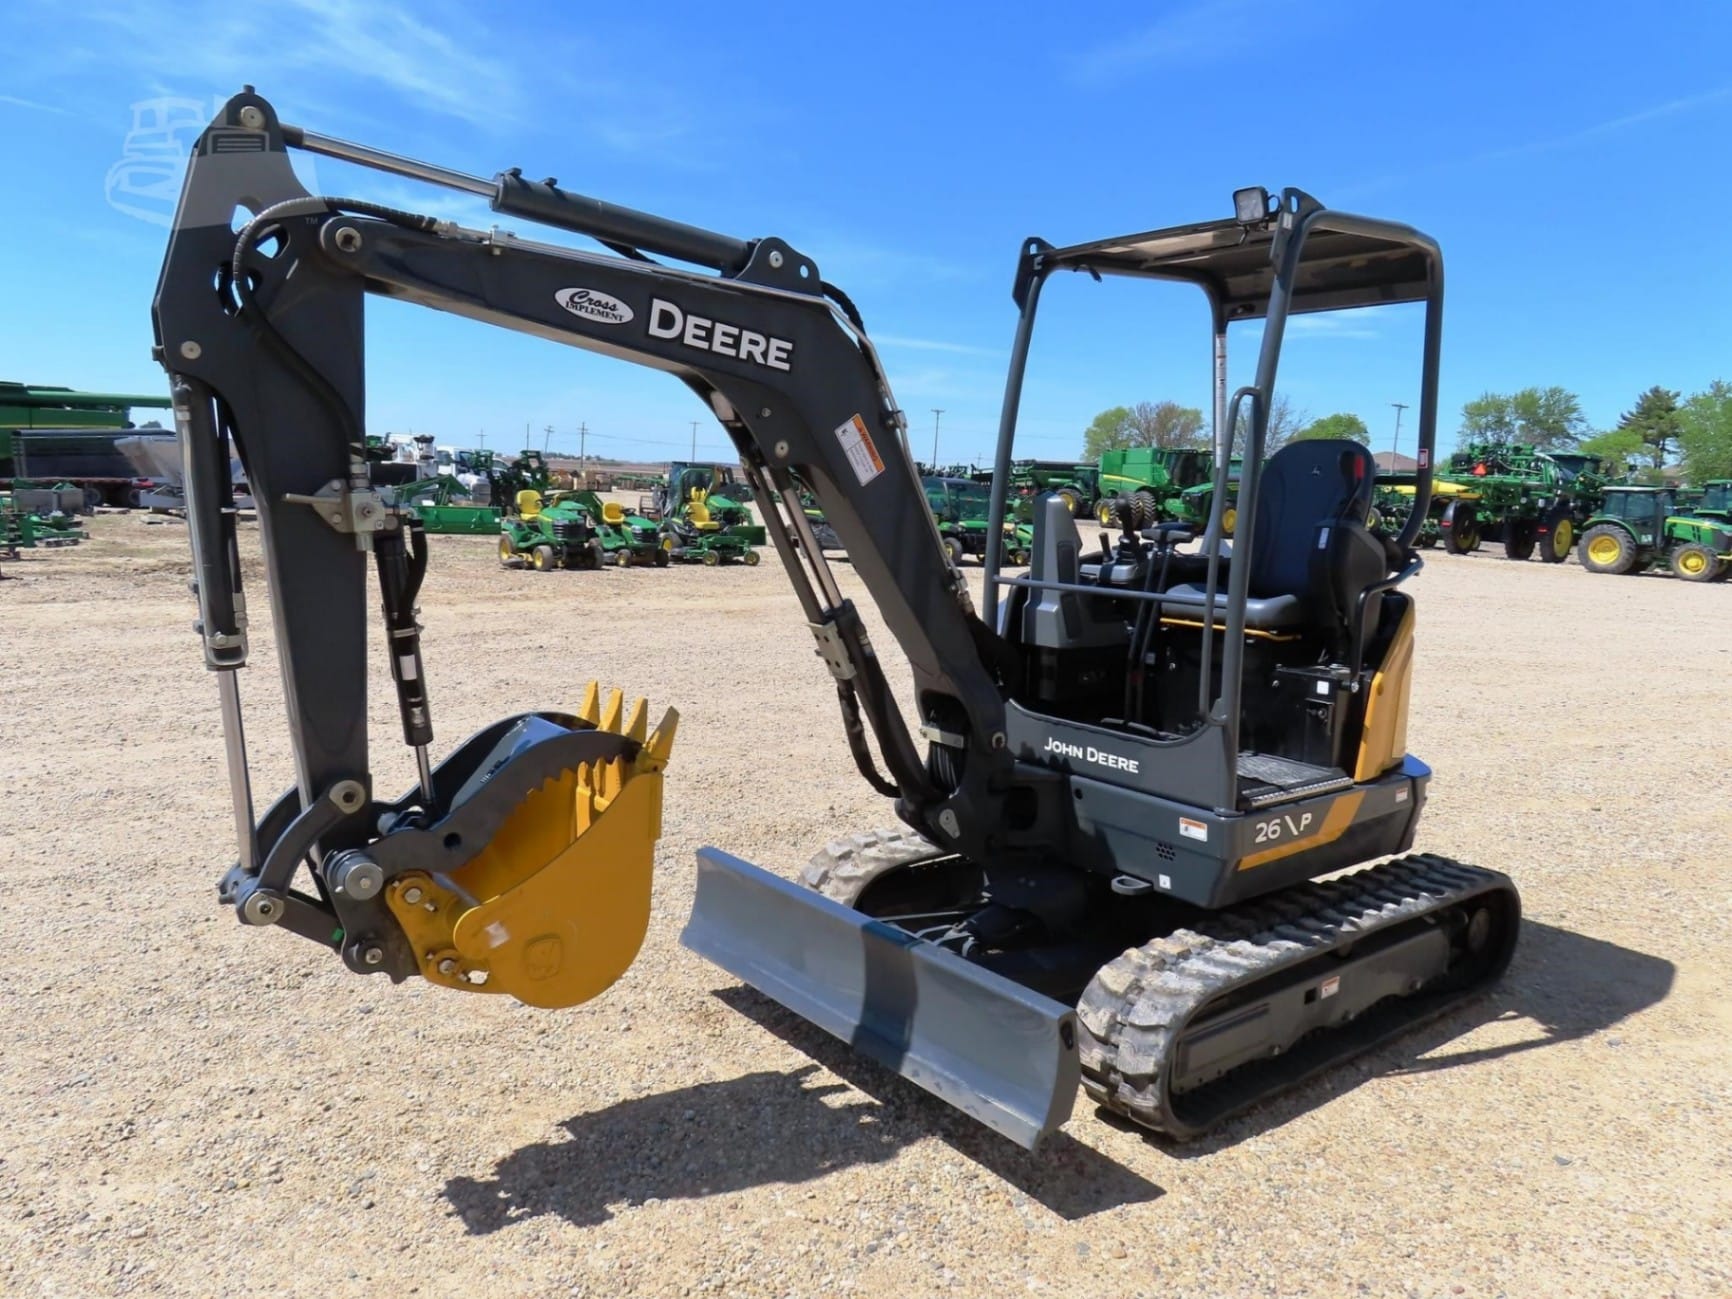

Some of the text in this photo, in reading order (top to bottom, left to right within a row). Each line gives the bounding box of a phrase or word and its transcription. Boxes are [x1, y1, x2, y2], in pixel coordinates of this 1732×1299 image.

[565, 301, 624, 321] IMPLEMENT
[569, 290, 618, 311] Cross
[648, 298, 793, 371] DEERE
[1044, 736, 1139, 773] JOHN DEERE
